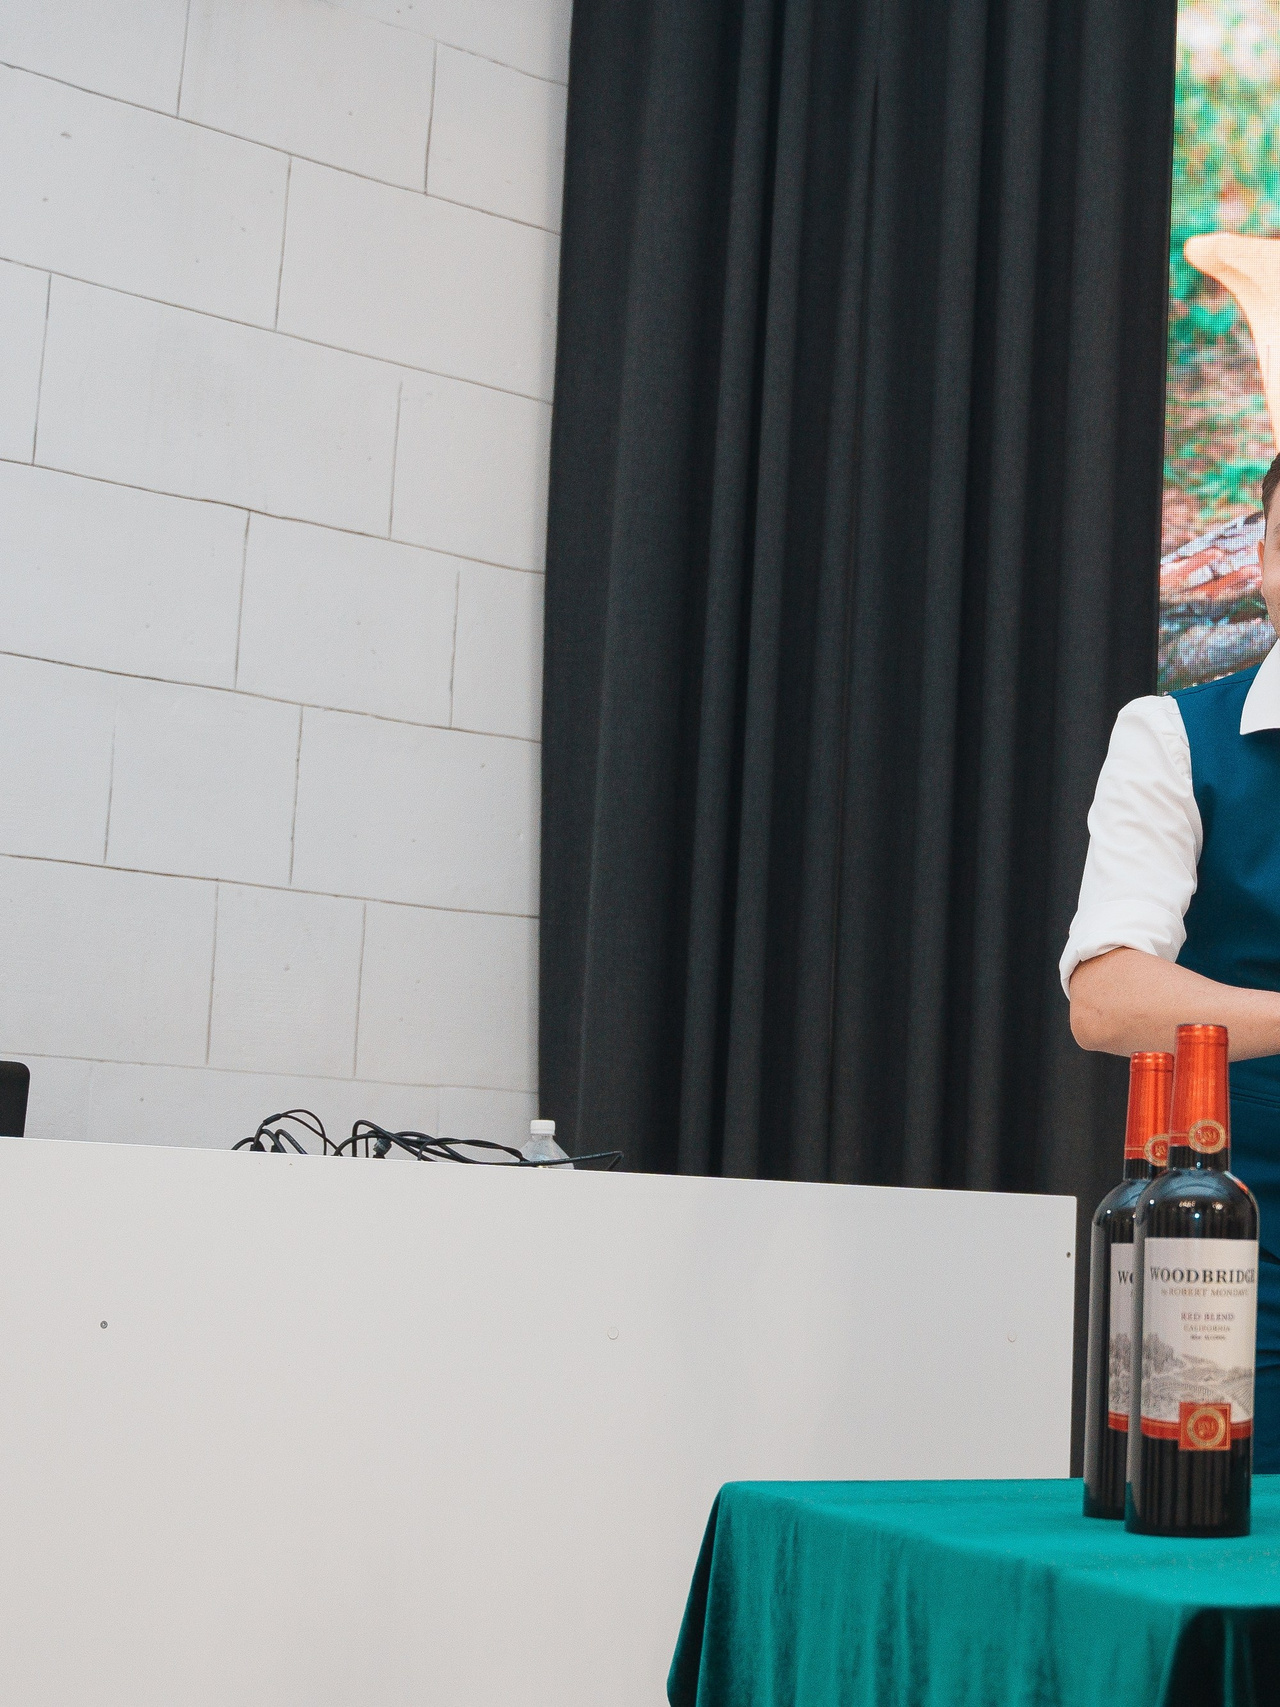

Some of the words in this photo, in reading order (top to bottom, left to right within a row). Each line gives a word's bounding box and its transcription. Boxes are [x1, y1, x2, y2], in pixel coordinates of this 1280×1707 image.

[1150, 1266, 1256, 1284] WOODBRIDGE
[1168, 1287, 1207, 1297] ROBERT
[1181, 1312, 1201, 1321] RED
[1204, 1312, 1235, 1321] BLEND
